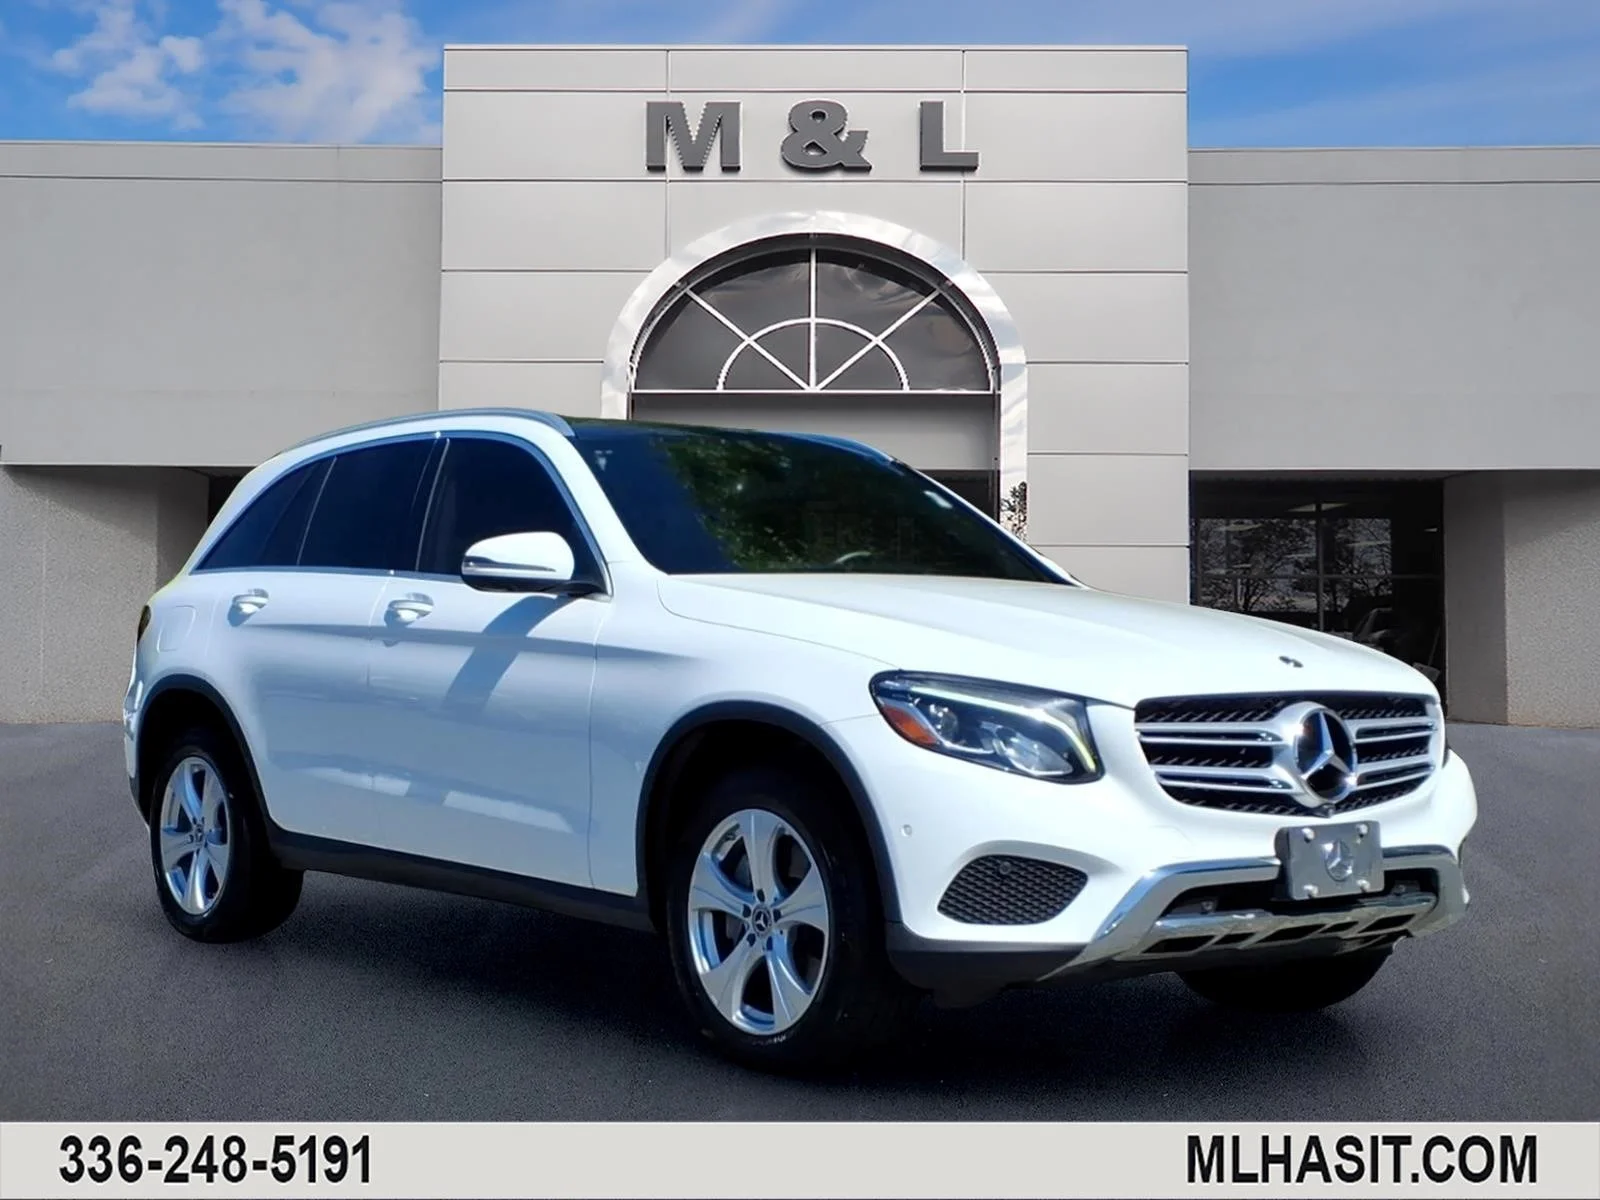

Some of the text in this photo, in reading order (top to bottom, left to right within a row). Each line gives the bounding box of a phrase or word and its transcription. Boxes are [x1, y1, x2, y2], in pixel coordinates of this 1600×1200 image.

[646, 101, 979, 174] M & L
